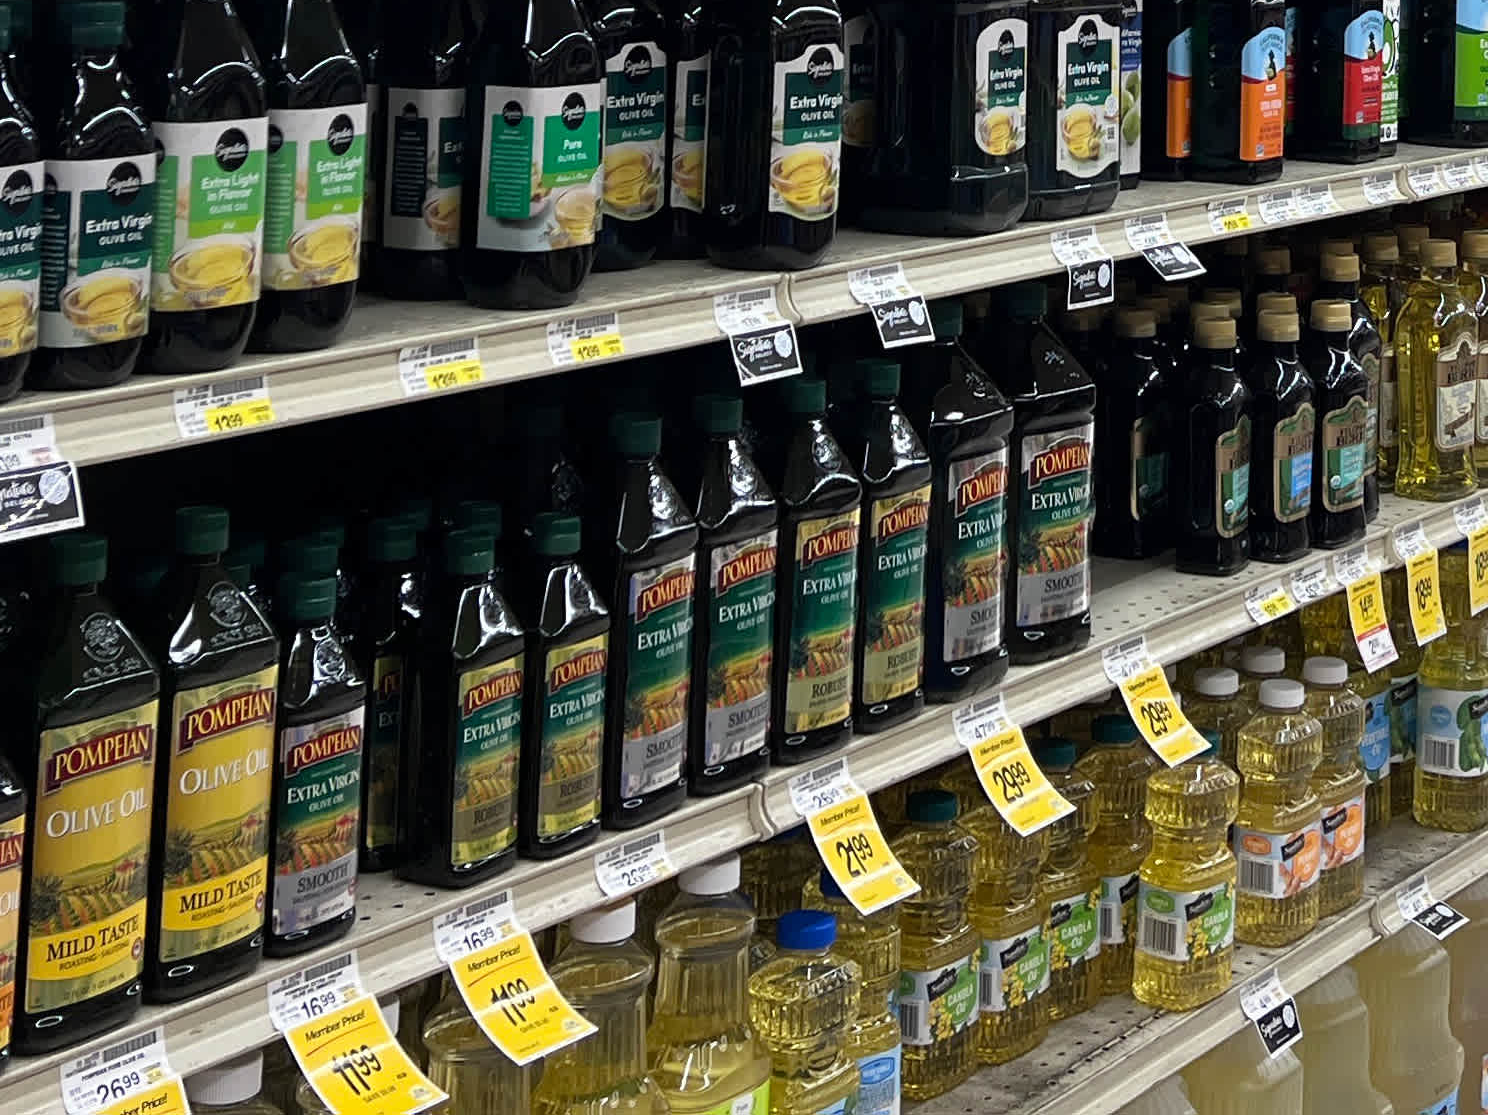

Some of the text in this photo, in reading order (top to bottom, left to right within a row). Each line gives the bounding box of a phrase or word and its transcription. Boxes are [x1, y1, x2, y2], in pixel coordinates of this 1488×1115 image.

[1068, 60, 1109, 76] Extra Virgin
[607, 92, 665, 109] Extra Virgin
[790, 93, 843, 111] Extra Virgin
[619, 110, 655, 121] OLIVE OIL
[801, 111, 835, 122] OLIVE OIL
[562, 138, 582, 150] Pure
[316, 155, 362, 173] Extra Light
[330, 170, 357, 184] Flavor
[201, 171, 260, 191] Extra Light
[207, 187, 252, 202] in Flavor
[86, 213, 152, 235] Extra Virgin
[98, 232, 143, 246] OLIVE OIL
[1035, 447, 1090, 479] POMPEIAN
[1031, 491, 1067, 510] EXTRA
[882, 504, 929, 537] POMPEIAN
[958, 519, 988, 540] EXTRA
[722, 546, 776, 583] POMPEIAN
[878, 553, 907, 571] EXTRA
[641, 574, 695, 612] POMPEIAN
[803, 575, 835, 595] EXTRA
[1414, 577, 1433, 612] 1899
[719, 601, 752, 623] EXTRA
[637, 627, 670, 650] EXTRA
[553, 651, 606, 687] POMPEIAN
[468, 671, 521, 710] POMPEIAN
[186, 693, 272, 740] POMPEIAN
[550, 697, 580, 719] EXTRA
[1140, 701, 1173, 738] 2999
[464, 720, 496, 743] EXTRA
[54, 730, 150, 780] POMPEIAN
[292, 728, 360, 769] POMPEIAN
[180, 750, 269, 795] OLIVE OIL
[993, 761, 1031, 805] 2999
[287, 770, 360, 805] EXTRA VIRGIN
[47, 789, 148, 838] OLIVE OIL
[819, 811, 845, 828] Member
[836, 833, 873, 879] 2199
[179, 872, 262, 914] MILD TASTE
[297, 865, 349, 895] SMOOTH
[46, 915, 139, 962] MILD TASTE
[462, 927, 495, 952] 1699
[1060, 920, 1092, 939] CANOLA
[467, 944, 521, 973] Member Price!
[1019, 953, 1044, 974] CANOLA
[299, 991, 336, 1021] 1699
[305, 1010, 366, 1042] Member Price!
[332, 1044, 381, 1096] 1199
[97, 1071, 141, 1104] 2699
